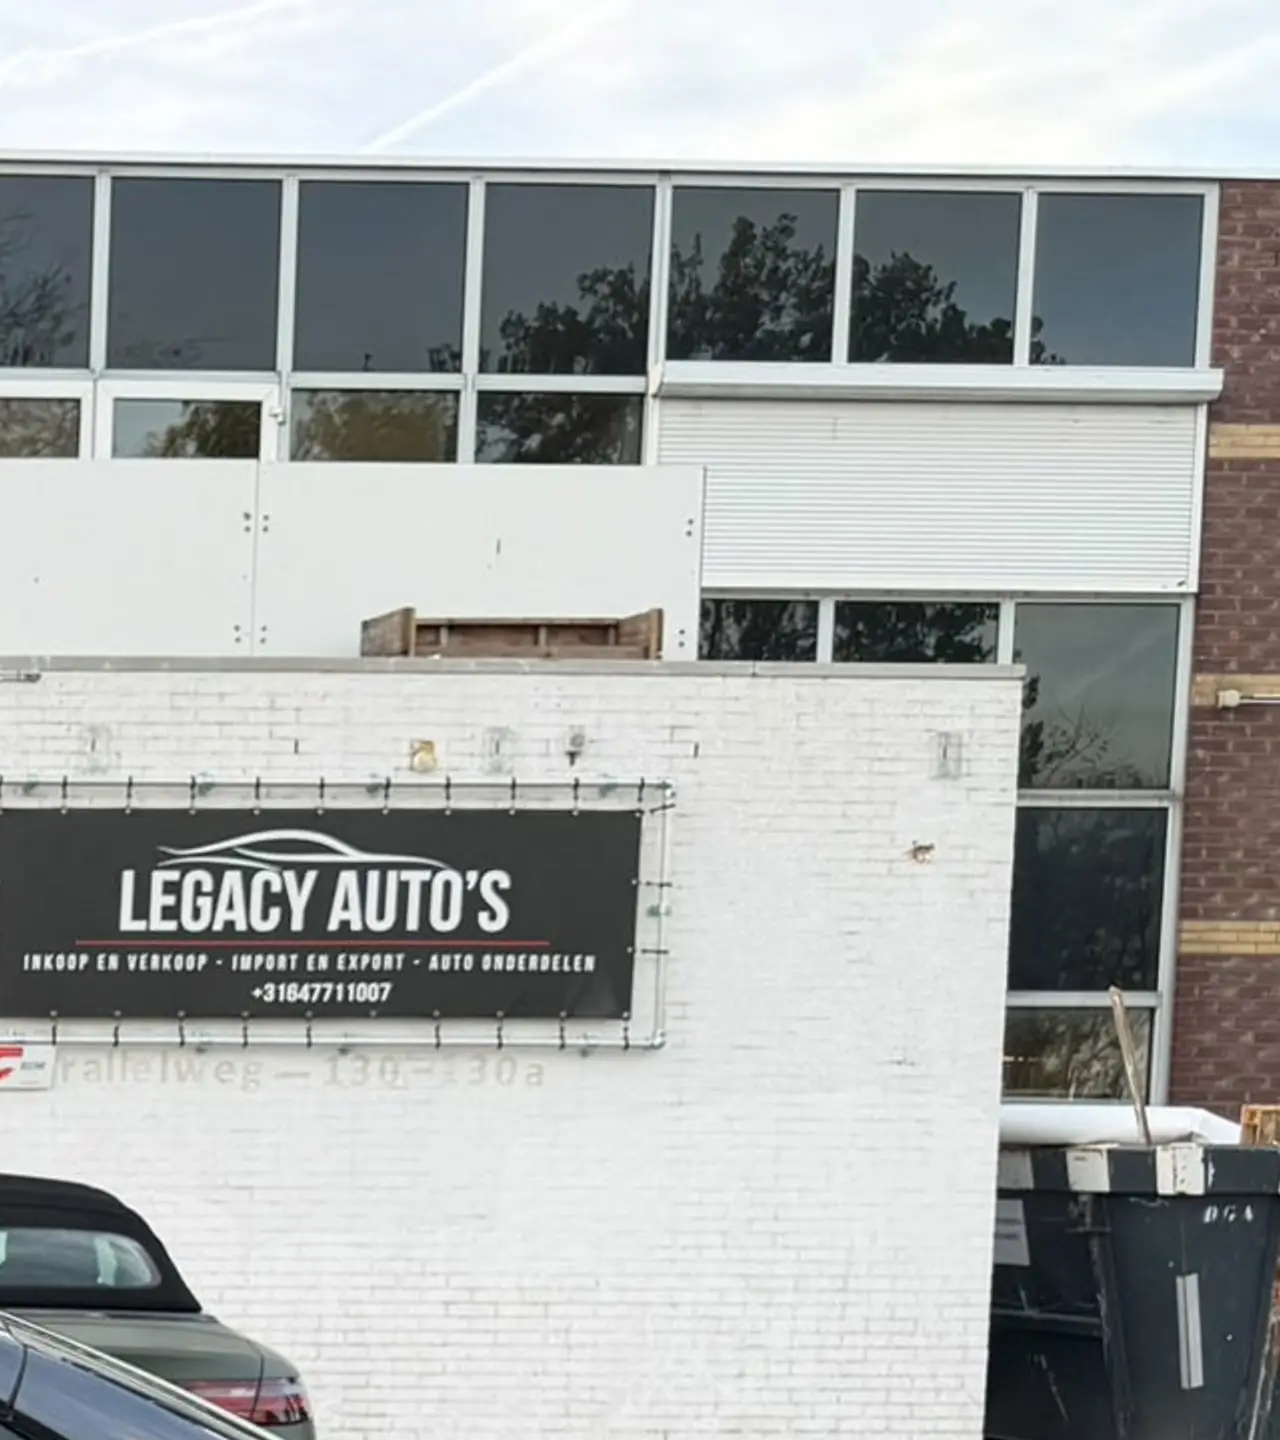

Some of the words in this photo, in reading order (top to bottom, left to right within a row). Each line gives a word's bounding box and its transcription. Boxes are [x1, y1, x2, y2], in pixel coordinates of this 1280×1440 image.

[119, 869, 318, 932] LEGACY
[327, 869, 512, 933] AUTO'S
[23, 953, 89, 972] INKOOP
[96, 953, 120, 972] EN
[127, 953, 208, 972] VERKOOP
[231, 953, 298, 972] IMPORT
[306, 953, 329, 972] EN
[336, 953, 405, 972] EXPORT
[428, 953, 474, 972] AUTO
[481, 954, 596, 973] ONDERDELEN
[251, 981, 393, 1003] +31647711007
